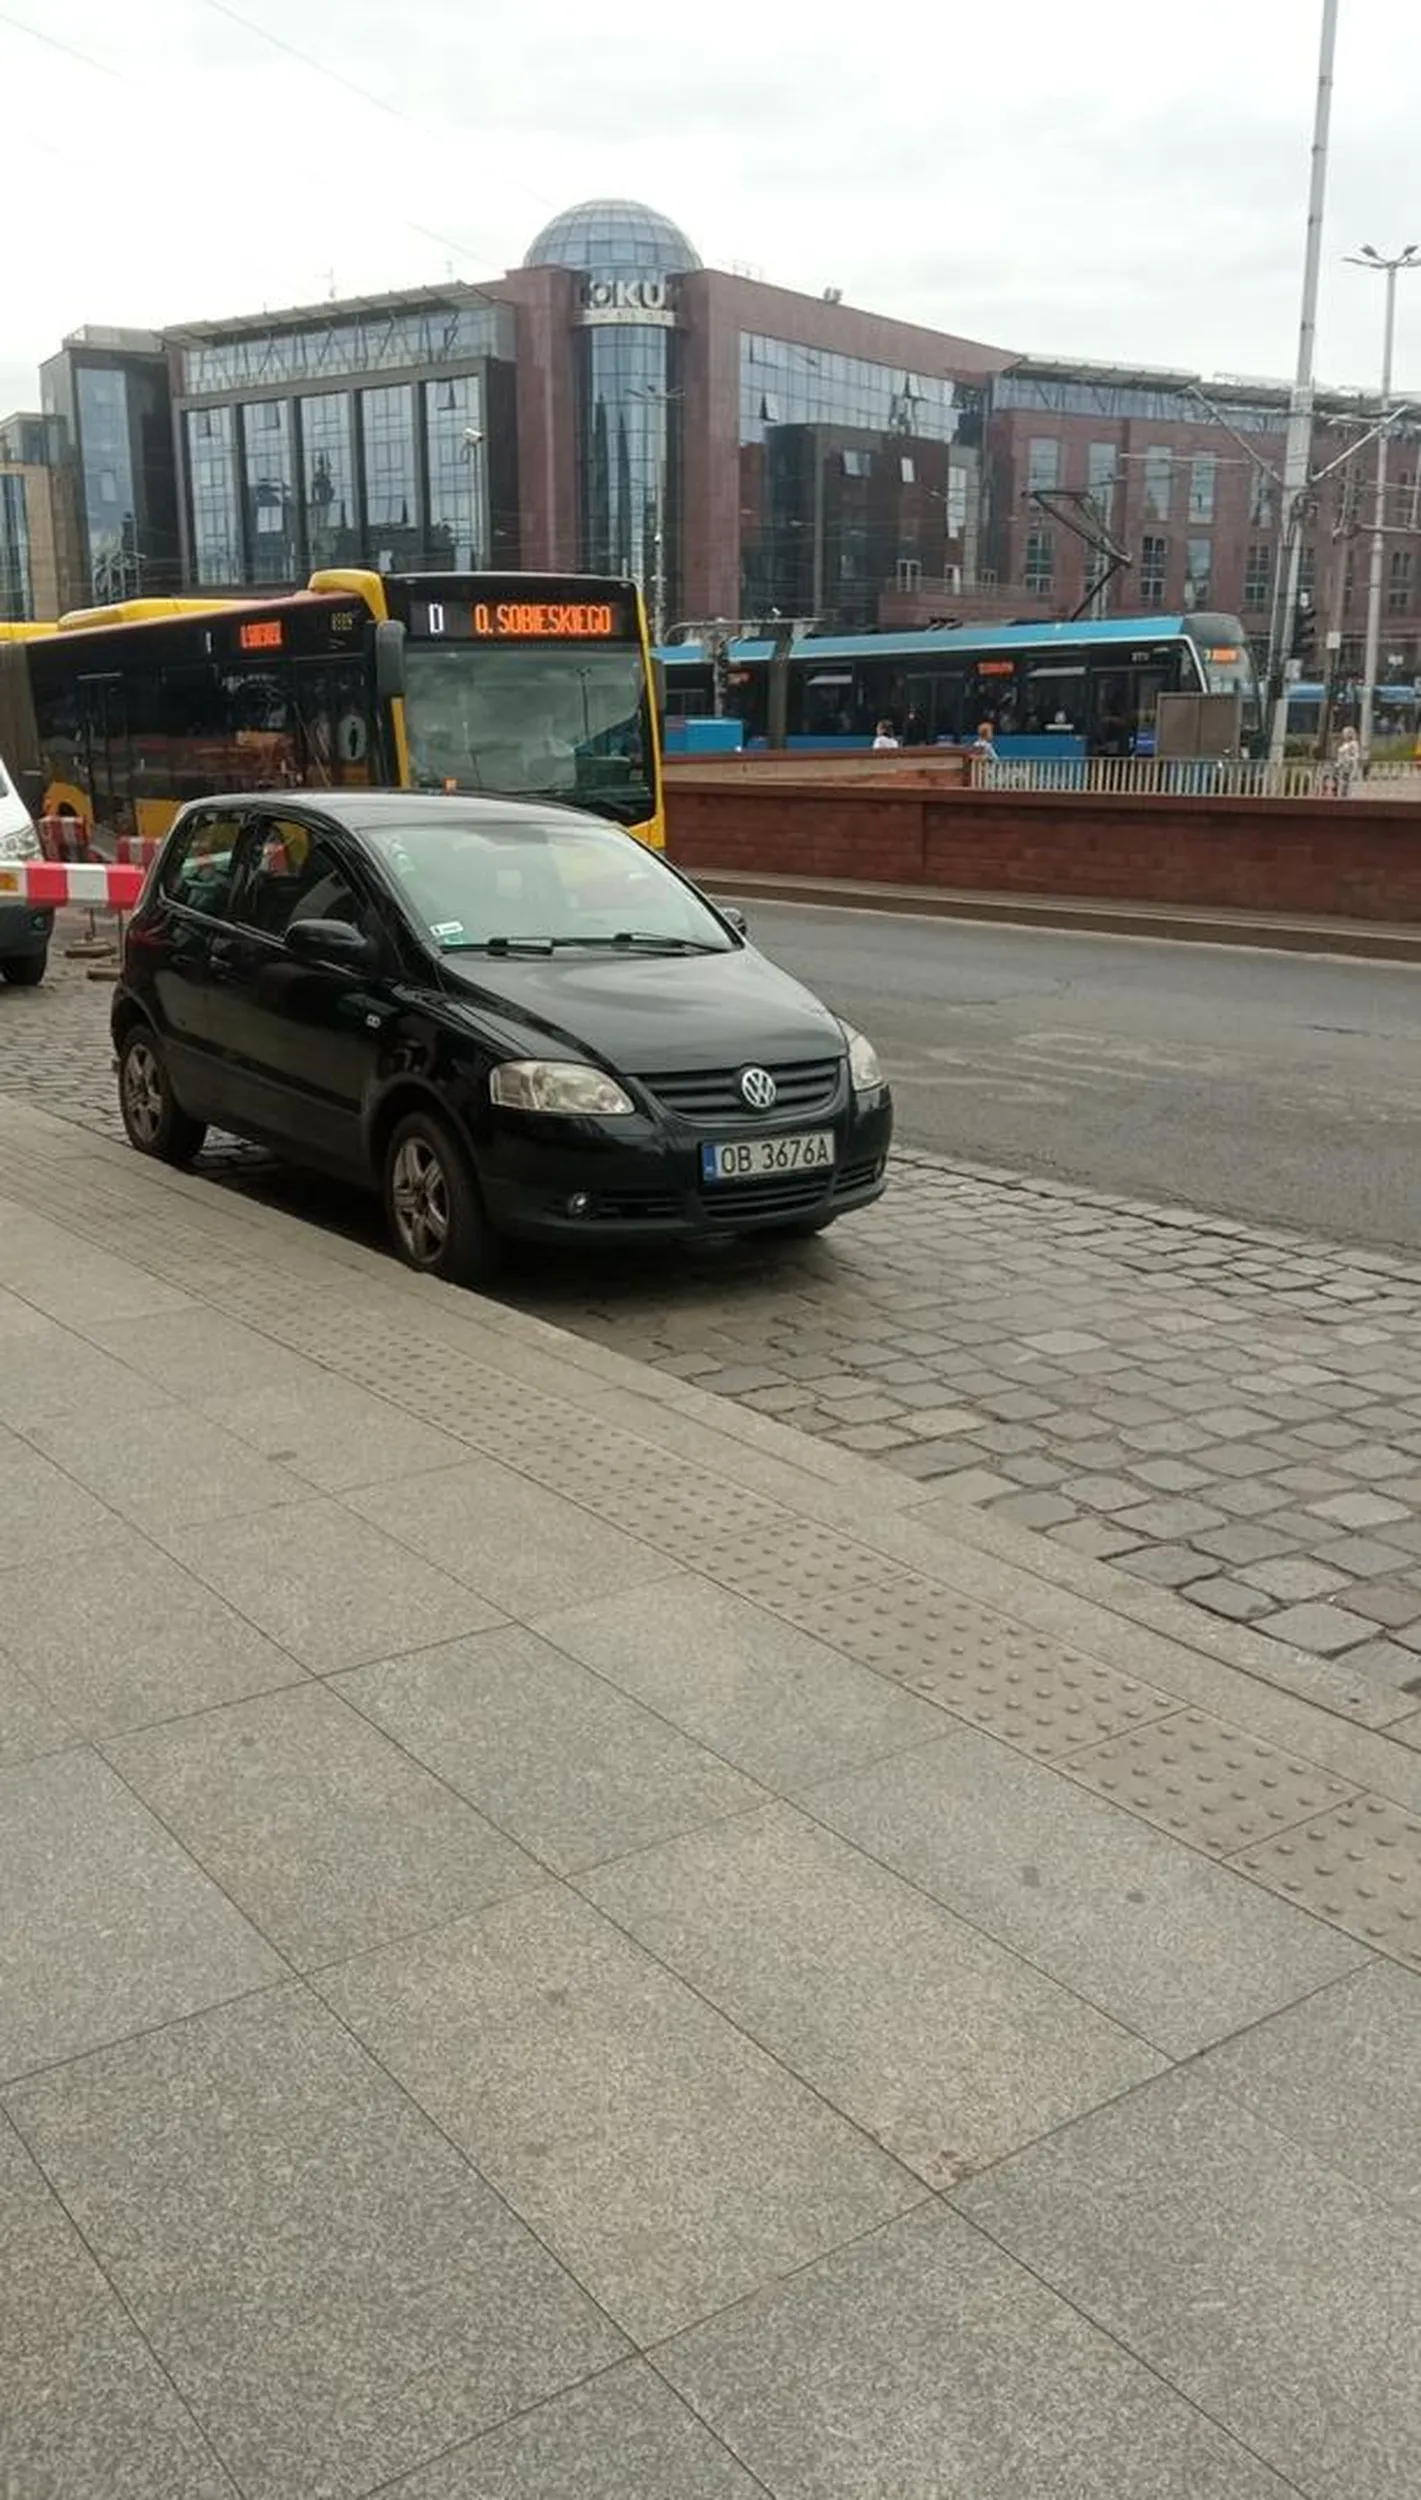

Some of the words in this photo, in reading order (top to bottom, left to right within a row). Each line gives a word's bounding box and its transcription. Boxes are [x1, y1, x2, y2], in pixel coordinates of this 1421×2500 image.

[428, 603, 444, 635] D
[474, 603, 494, 634] O.
[496, 603, 612, 634] SOBIESKIEGO
[742, 1069, 776, 1108] VW
[721, 1145, 753, 1174] OB
[761, 1137, 830, 1169] 3676A
